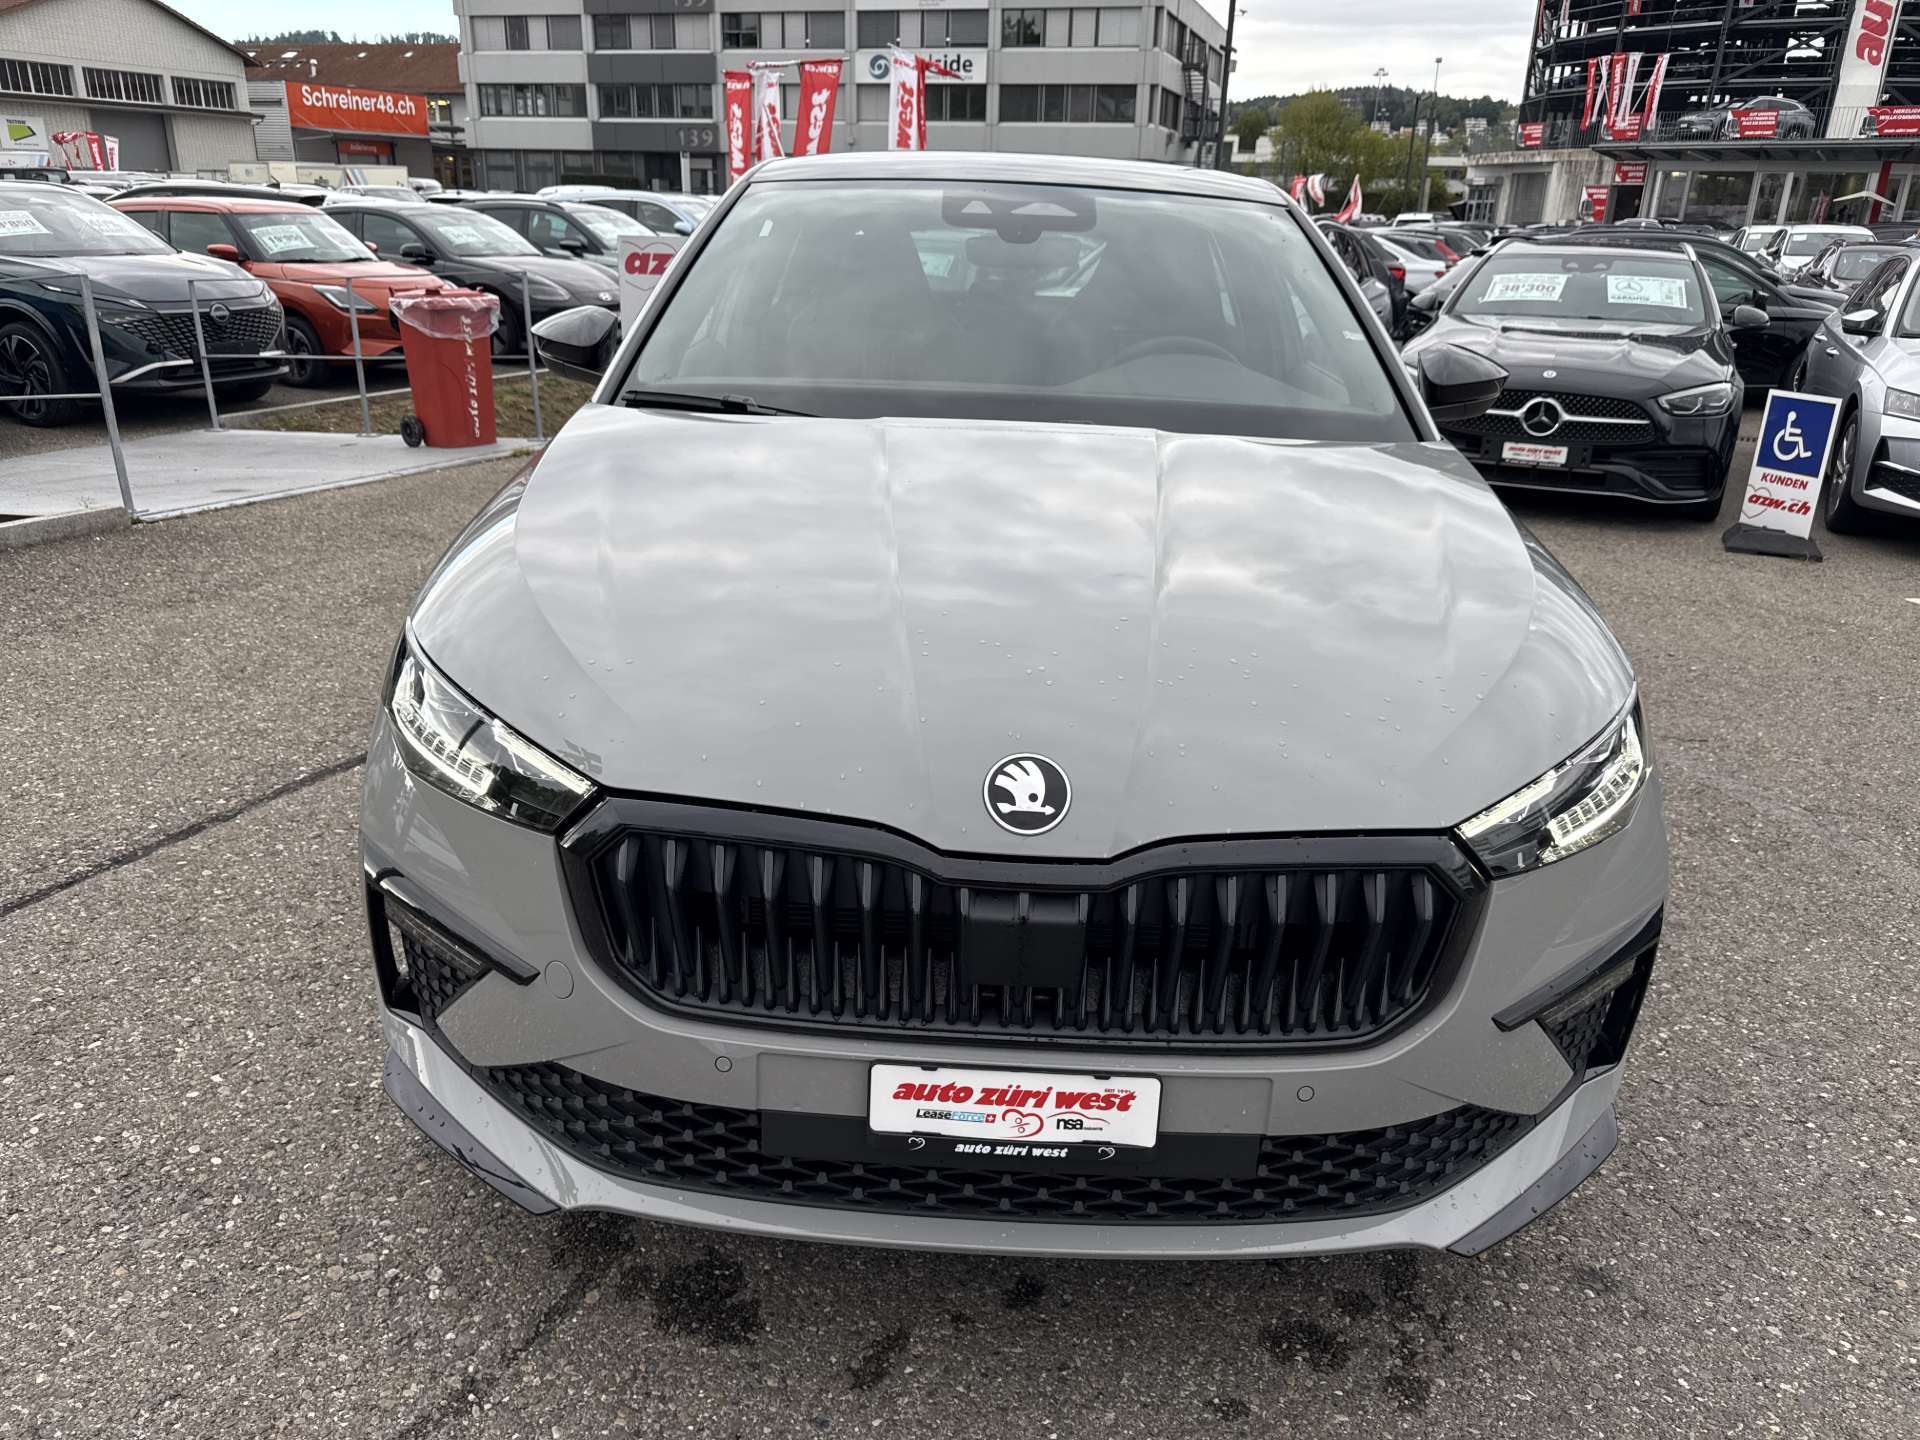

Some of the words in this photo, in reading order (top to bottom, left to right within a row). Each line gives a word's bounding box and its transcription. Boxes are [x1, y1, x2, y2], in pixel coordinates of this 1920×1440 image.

[301, 85, 416, 116] Schreiner48.ch
[896, 80, 914, 148] west
[678, 128, 713, 147] 139
[729, 102, 745, 169] west
[1760, 472, 1809, 490] KUNDEN
[1748, 494, 1811, 515] azw.ch
[892, 1081, 974, 1104] auto
[974, 1084, 1053, 1109] züri
[1055, 1091, 1137, 1112] west
[1056, 1118, 1084, 1130] nsa
[954, 1143, 992, 1154] auto
[993, 1145, 1029, 1156] züri
[1031, 1147, 1069, 1158] west
